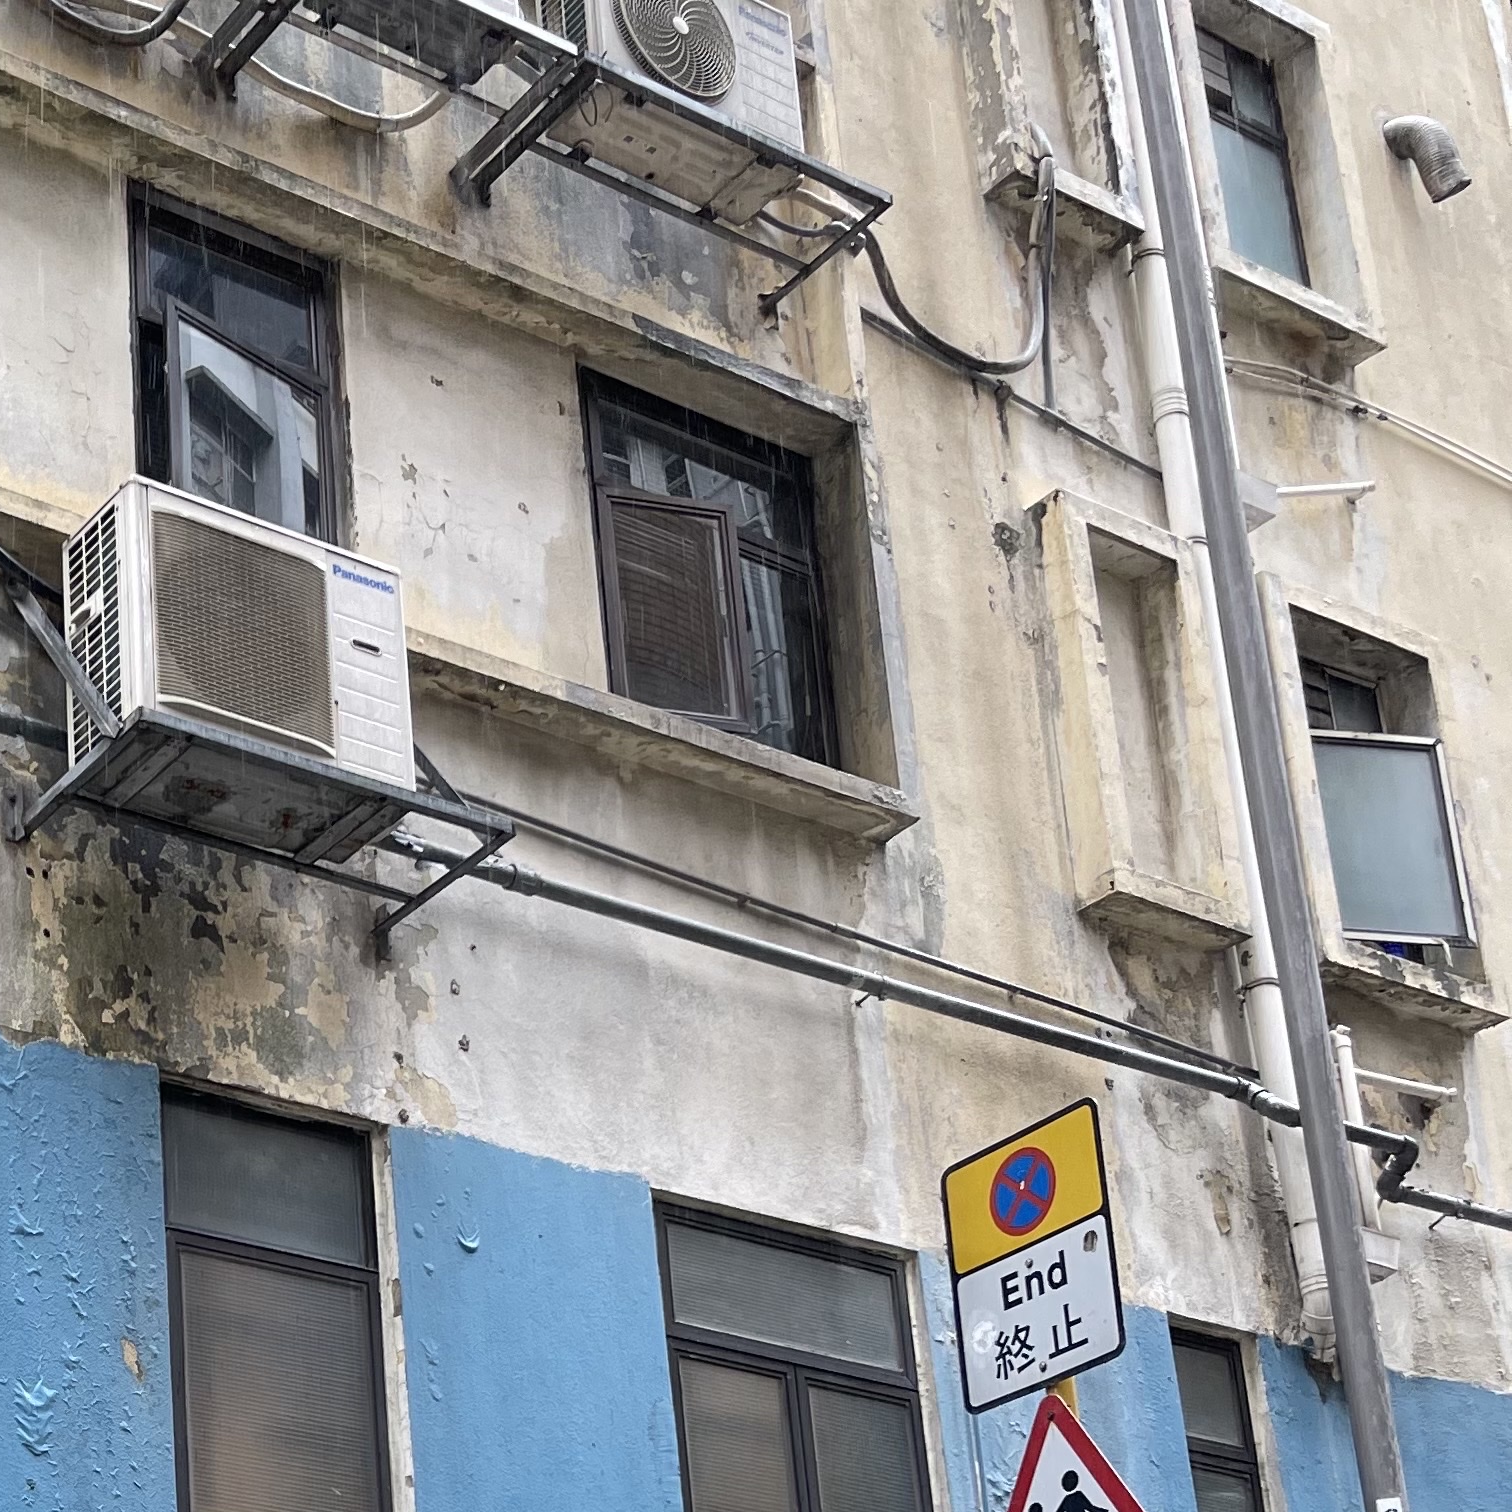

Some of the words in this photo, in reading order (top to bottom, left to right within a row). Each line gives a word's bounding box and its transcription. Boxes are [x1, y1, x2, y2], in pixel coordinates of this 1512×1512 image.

[332, 564, 394, 594] Panasonic
[1000, 1250, 1068, 1311] End
[995, 1303, 1089, 1380] 終止
